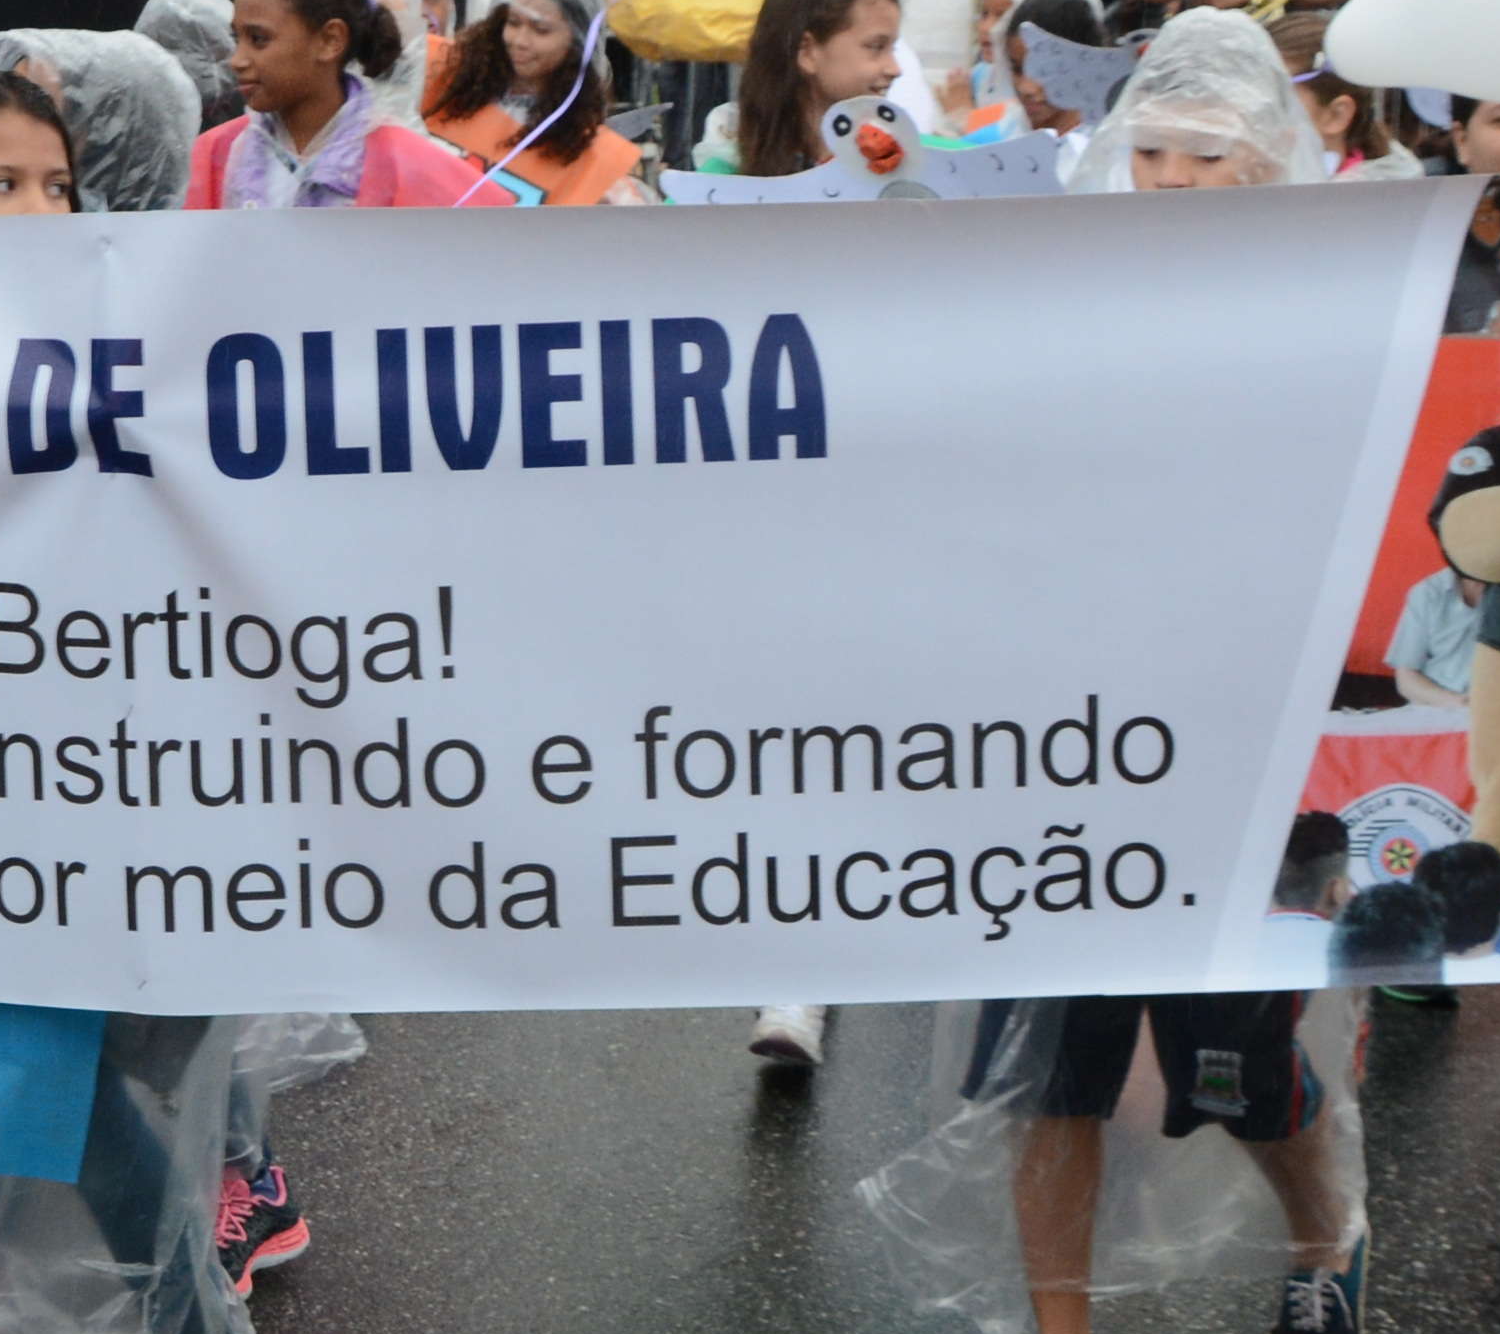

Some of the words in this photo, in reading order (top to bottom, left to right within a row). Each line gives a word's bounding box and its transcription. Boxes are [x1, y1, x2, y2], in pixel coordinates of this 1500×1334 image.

[5, 337, 155, 479] DE
[206, 313, 828, 480] OLIVEIRA
[531, 730, 595, 806] e
[634, 694, 1176, 801] formando
[125, 838, 386, 934] meio
[427, 841, 561, 933] da
[609, 822, 1198, 942] Educação.
